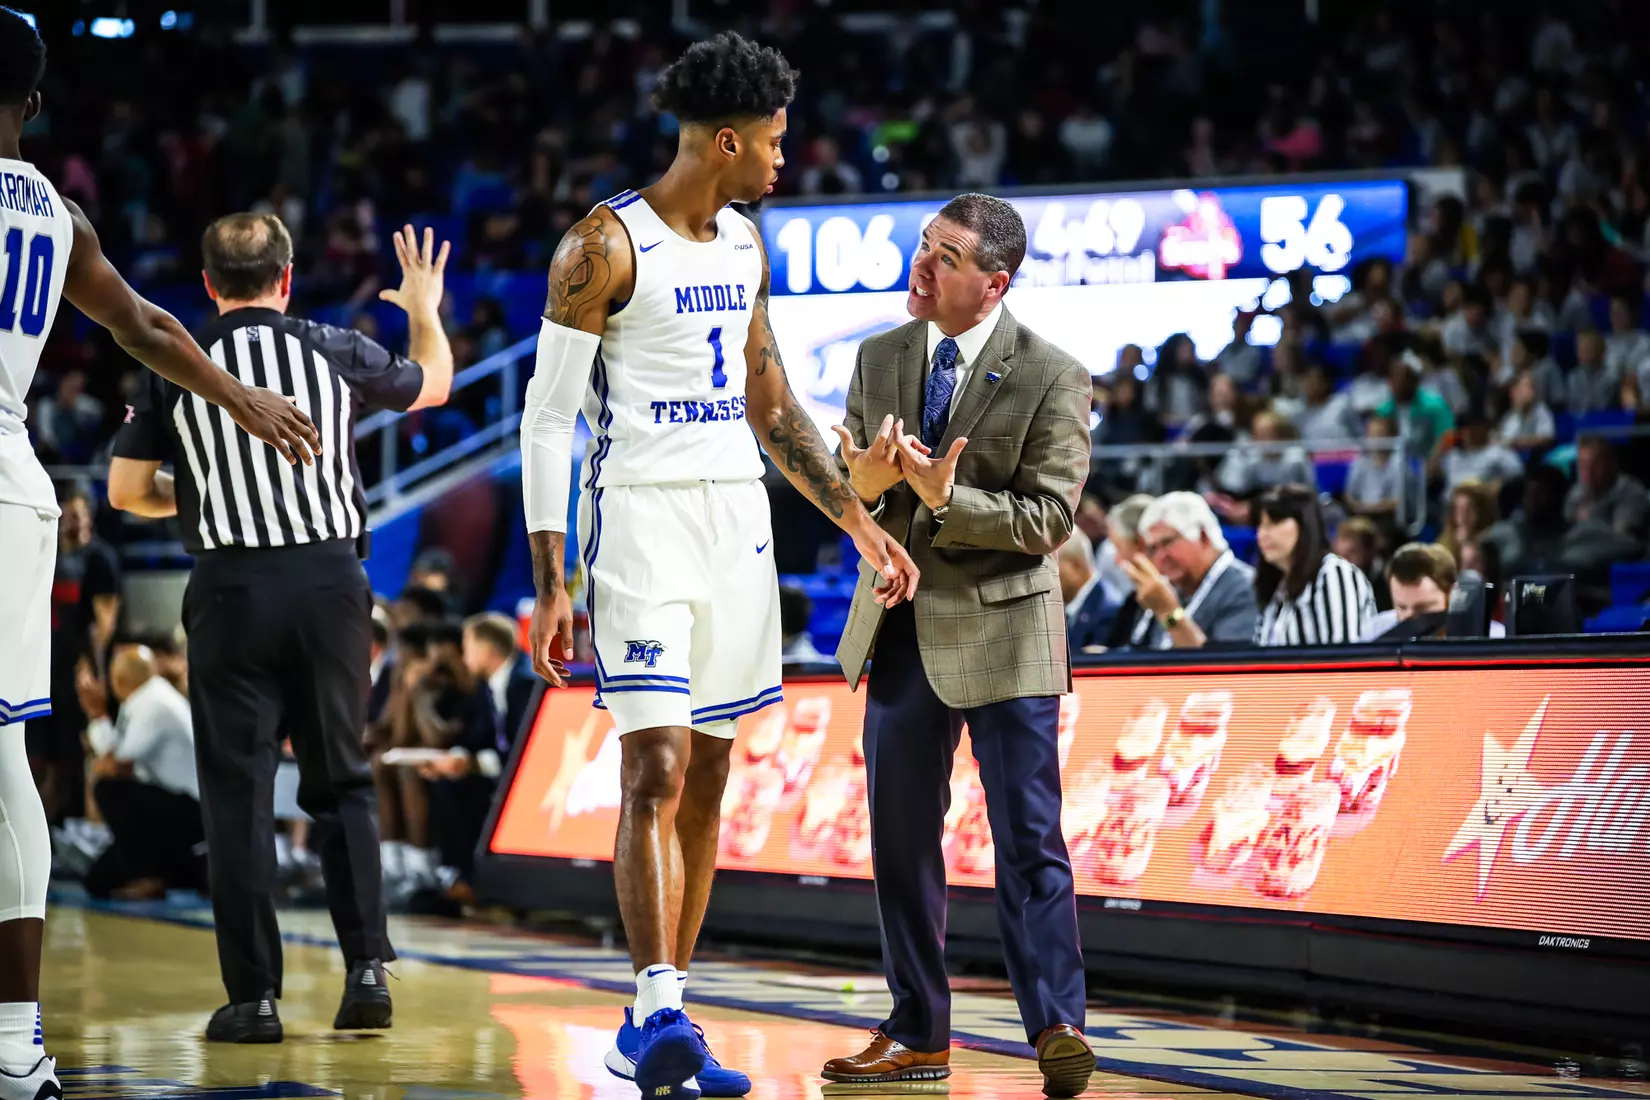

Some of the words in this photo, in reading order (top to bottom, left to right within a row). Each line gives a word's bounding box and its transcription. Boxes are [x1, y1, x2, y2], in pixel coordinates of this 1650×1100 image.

[776, 213, 903, 294] 106
[1260, 194, 1353, 273] 56
[0, 226, 54, 339] 10
[674, 284, 747, 314] MIDDLE
[707, 325, 728, 389] 1
[1538, 935, 1591, 949] DAKTRONICS
